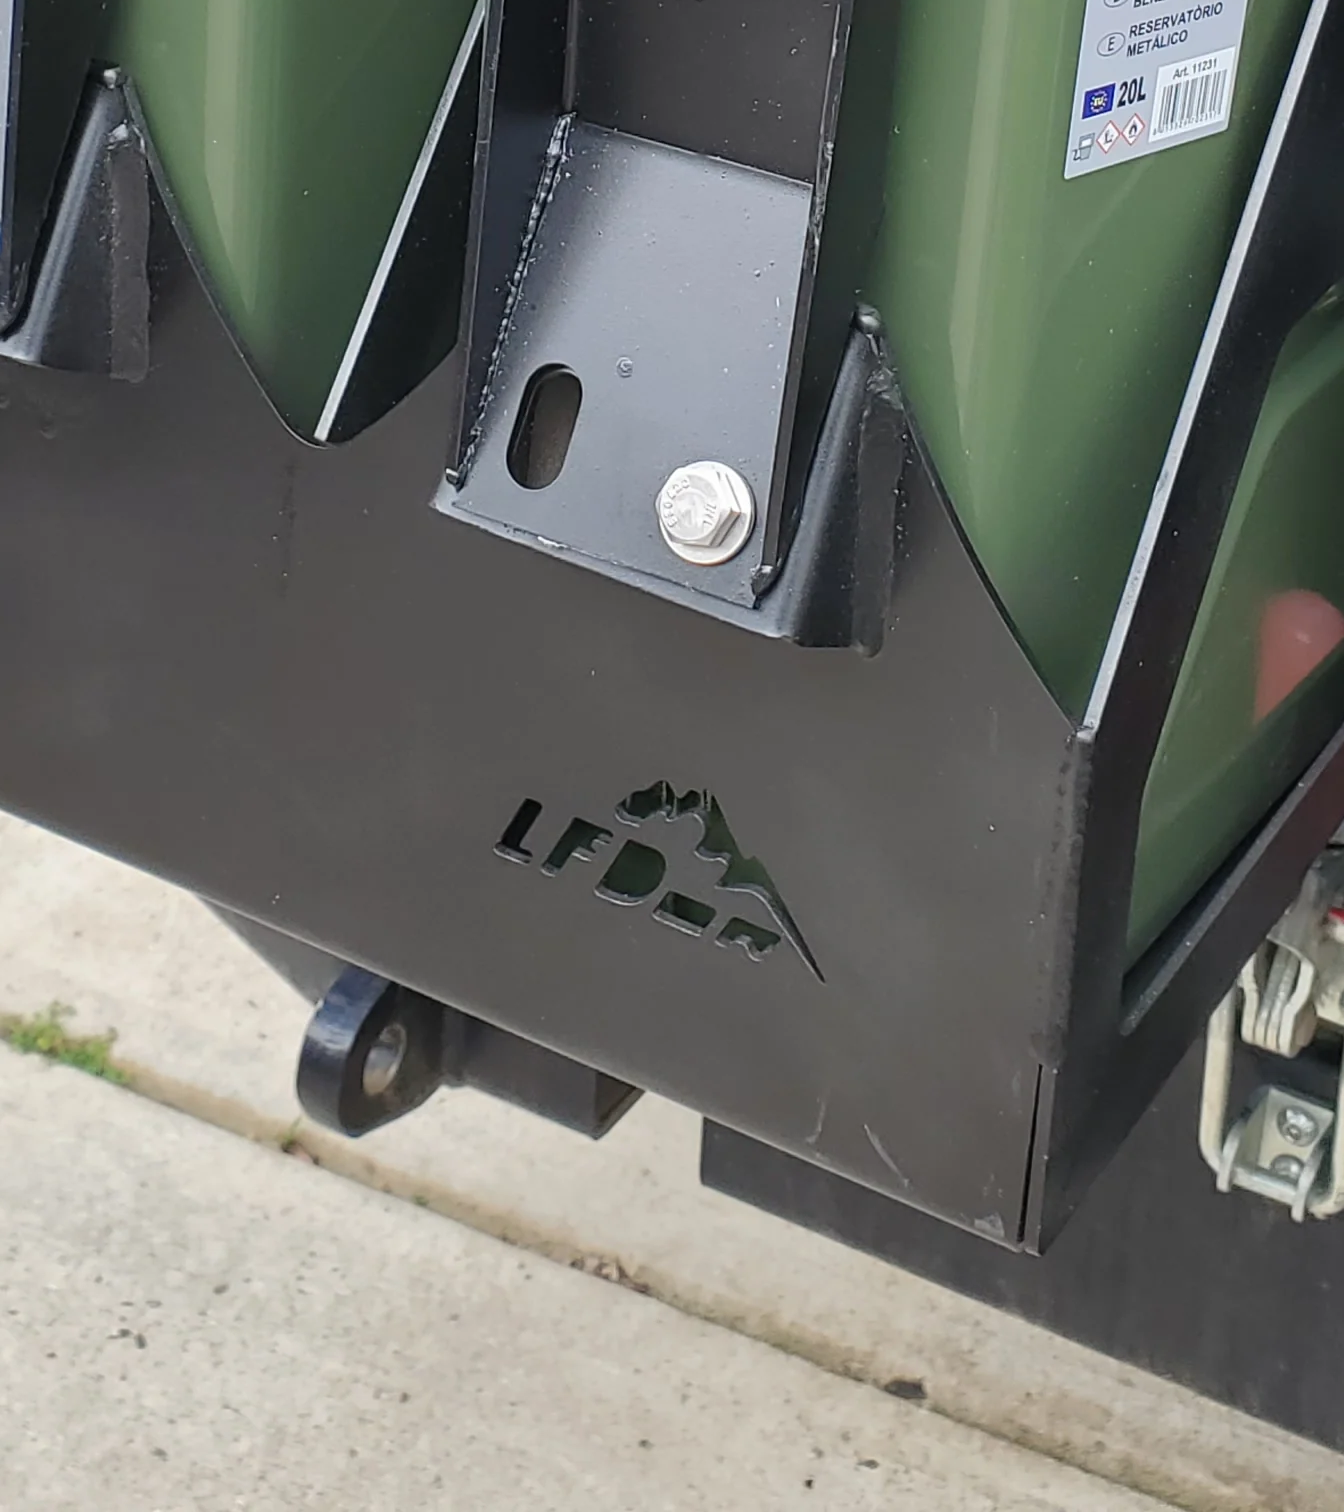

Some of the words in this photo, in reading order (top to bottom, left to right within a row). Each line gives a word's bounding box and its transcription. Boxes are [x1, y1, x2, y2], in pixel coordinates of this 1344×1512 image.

[1172, 67, 1189, 80] Art.
[1192, 58, 1217, 75] 11231
[1117, 76, 1146, 108] 20L
